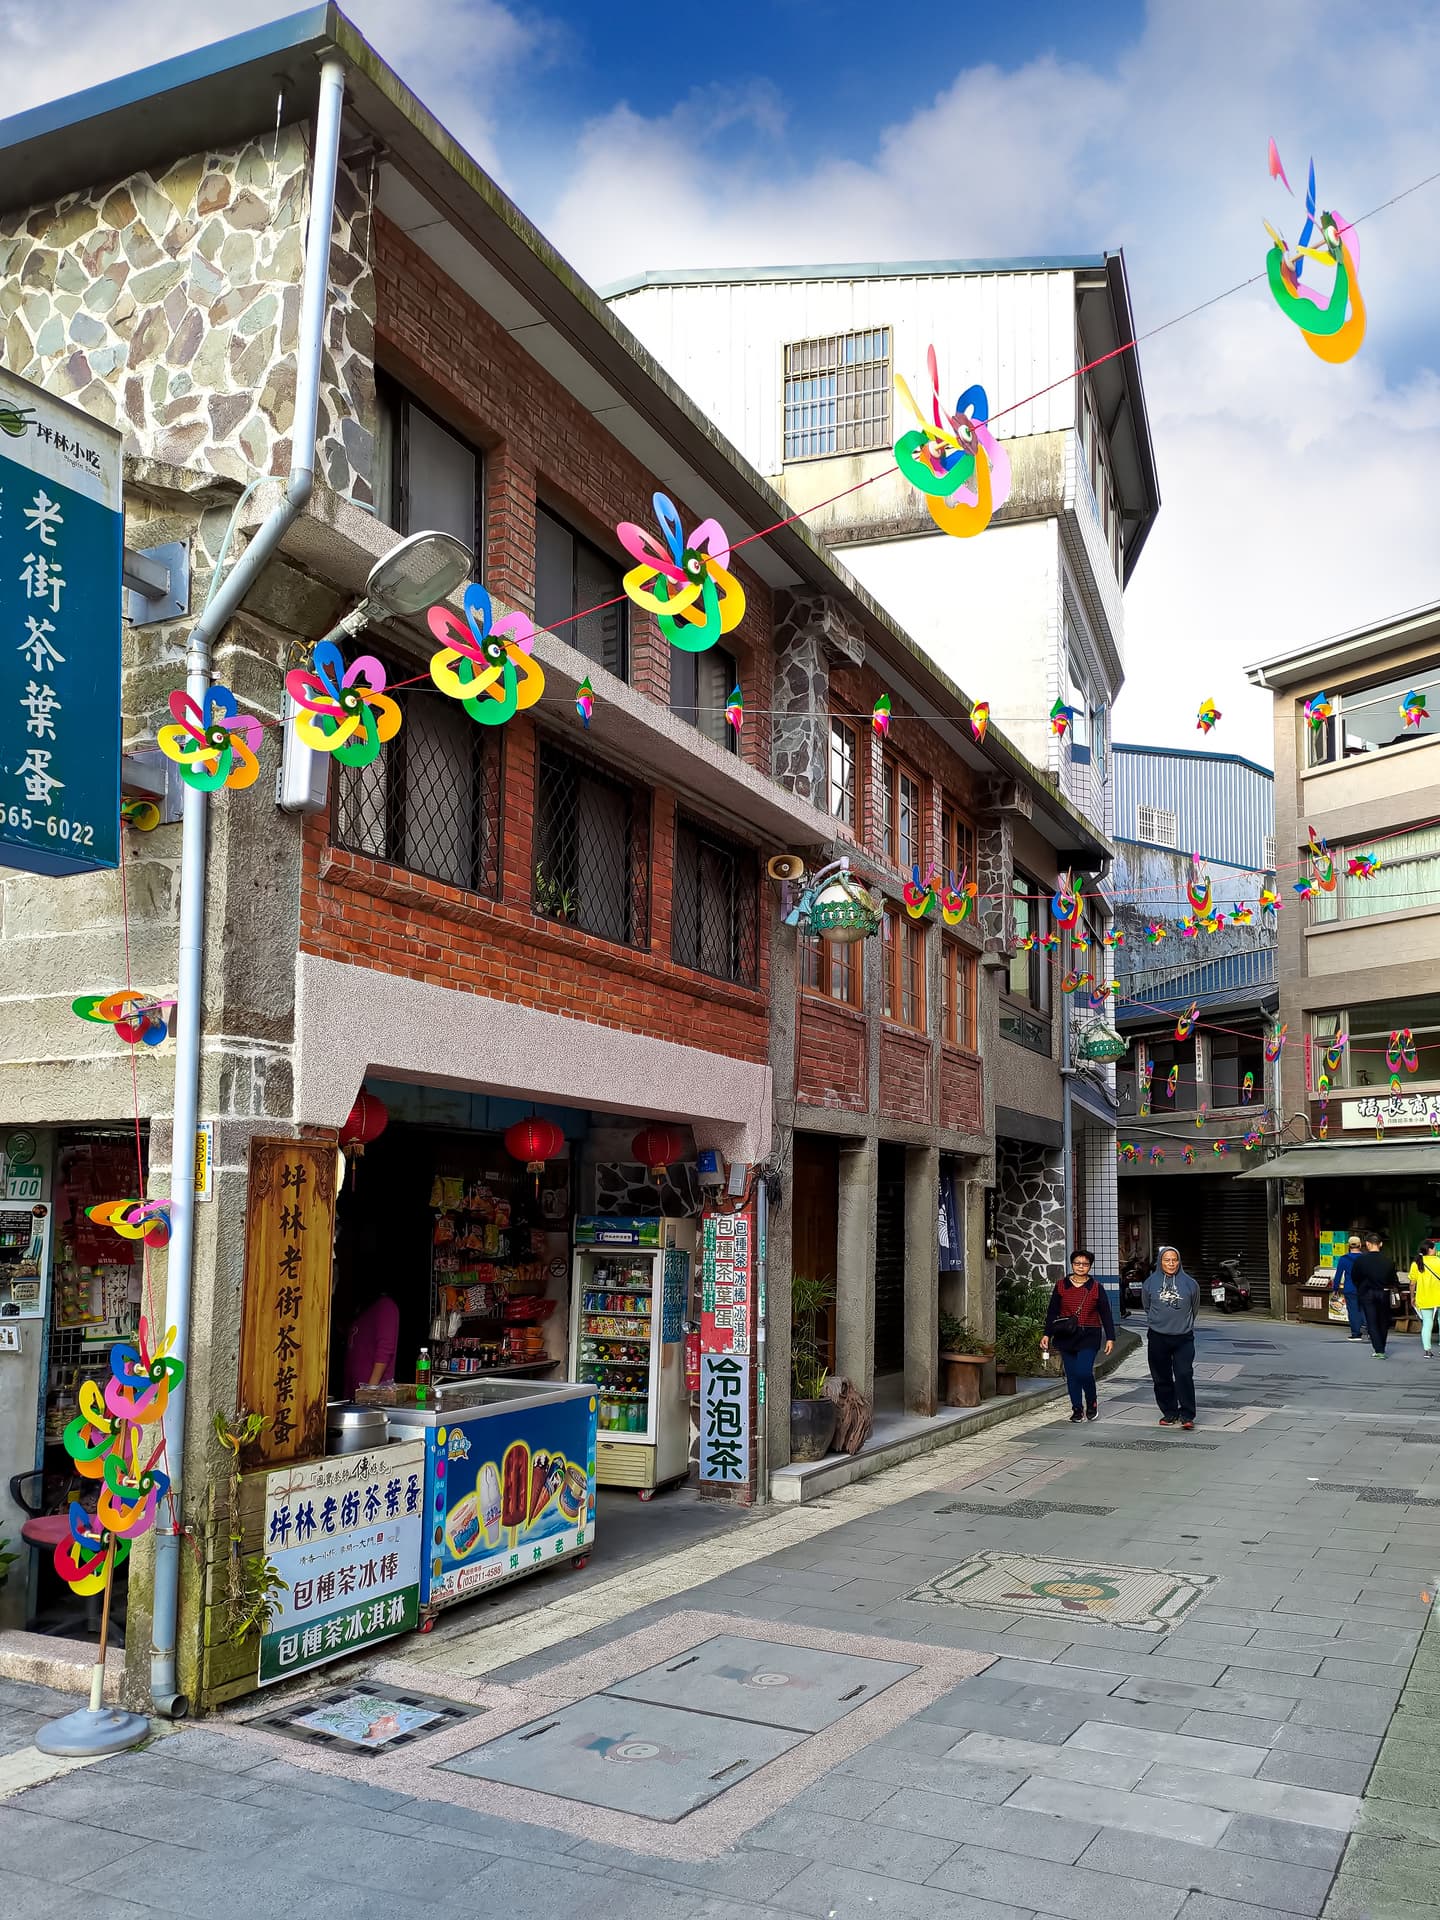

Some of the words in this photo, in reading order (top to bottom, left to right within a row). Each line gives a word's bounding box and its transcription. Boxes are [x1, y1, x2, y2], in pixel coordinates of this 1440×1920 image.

[36, 422, 101, 470] 坪林小吃
[15, 489, 67, 806] 老街茶葉蛋
[10, 1180, 39, 1196] 100
[715, 1217, 734, 1328] 包種茶葉蛋
[1286, 1211, 1301, 1278] 坪林老街
[269, 1163, 308, 1447] 坪林老街茶葉蛋
[706, 1357, 743, 1480] 冷泡茶
[269, 1474, 421, 1546] 坪林老街茶葉蛋
[293, 1552, 399, 1612] 包種茶冰棒
[509, 1531, 586, 1570] 坪林老街
[278, 1594, 406, 1667] 包種茶冰淇淋
